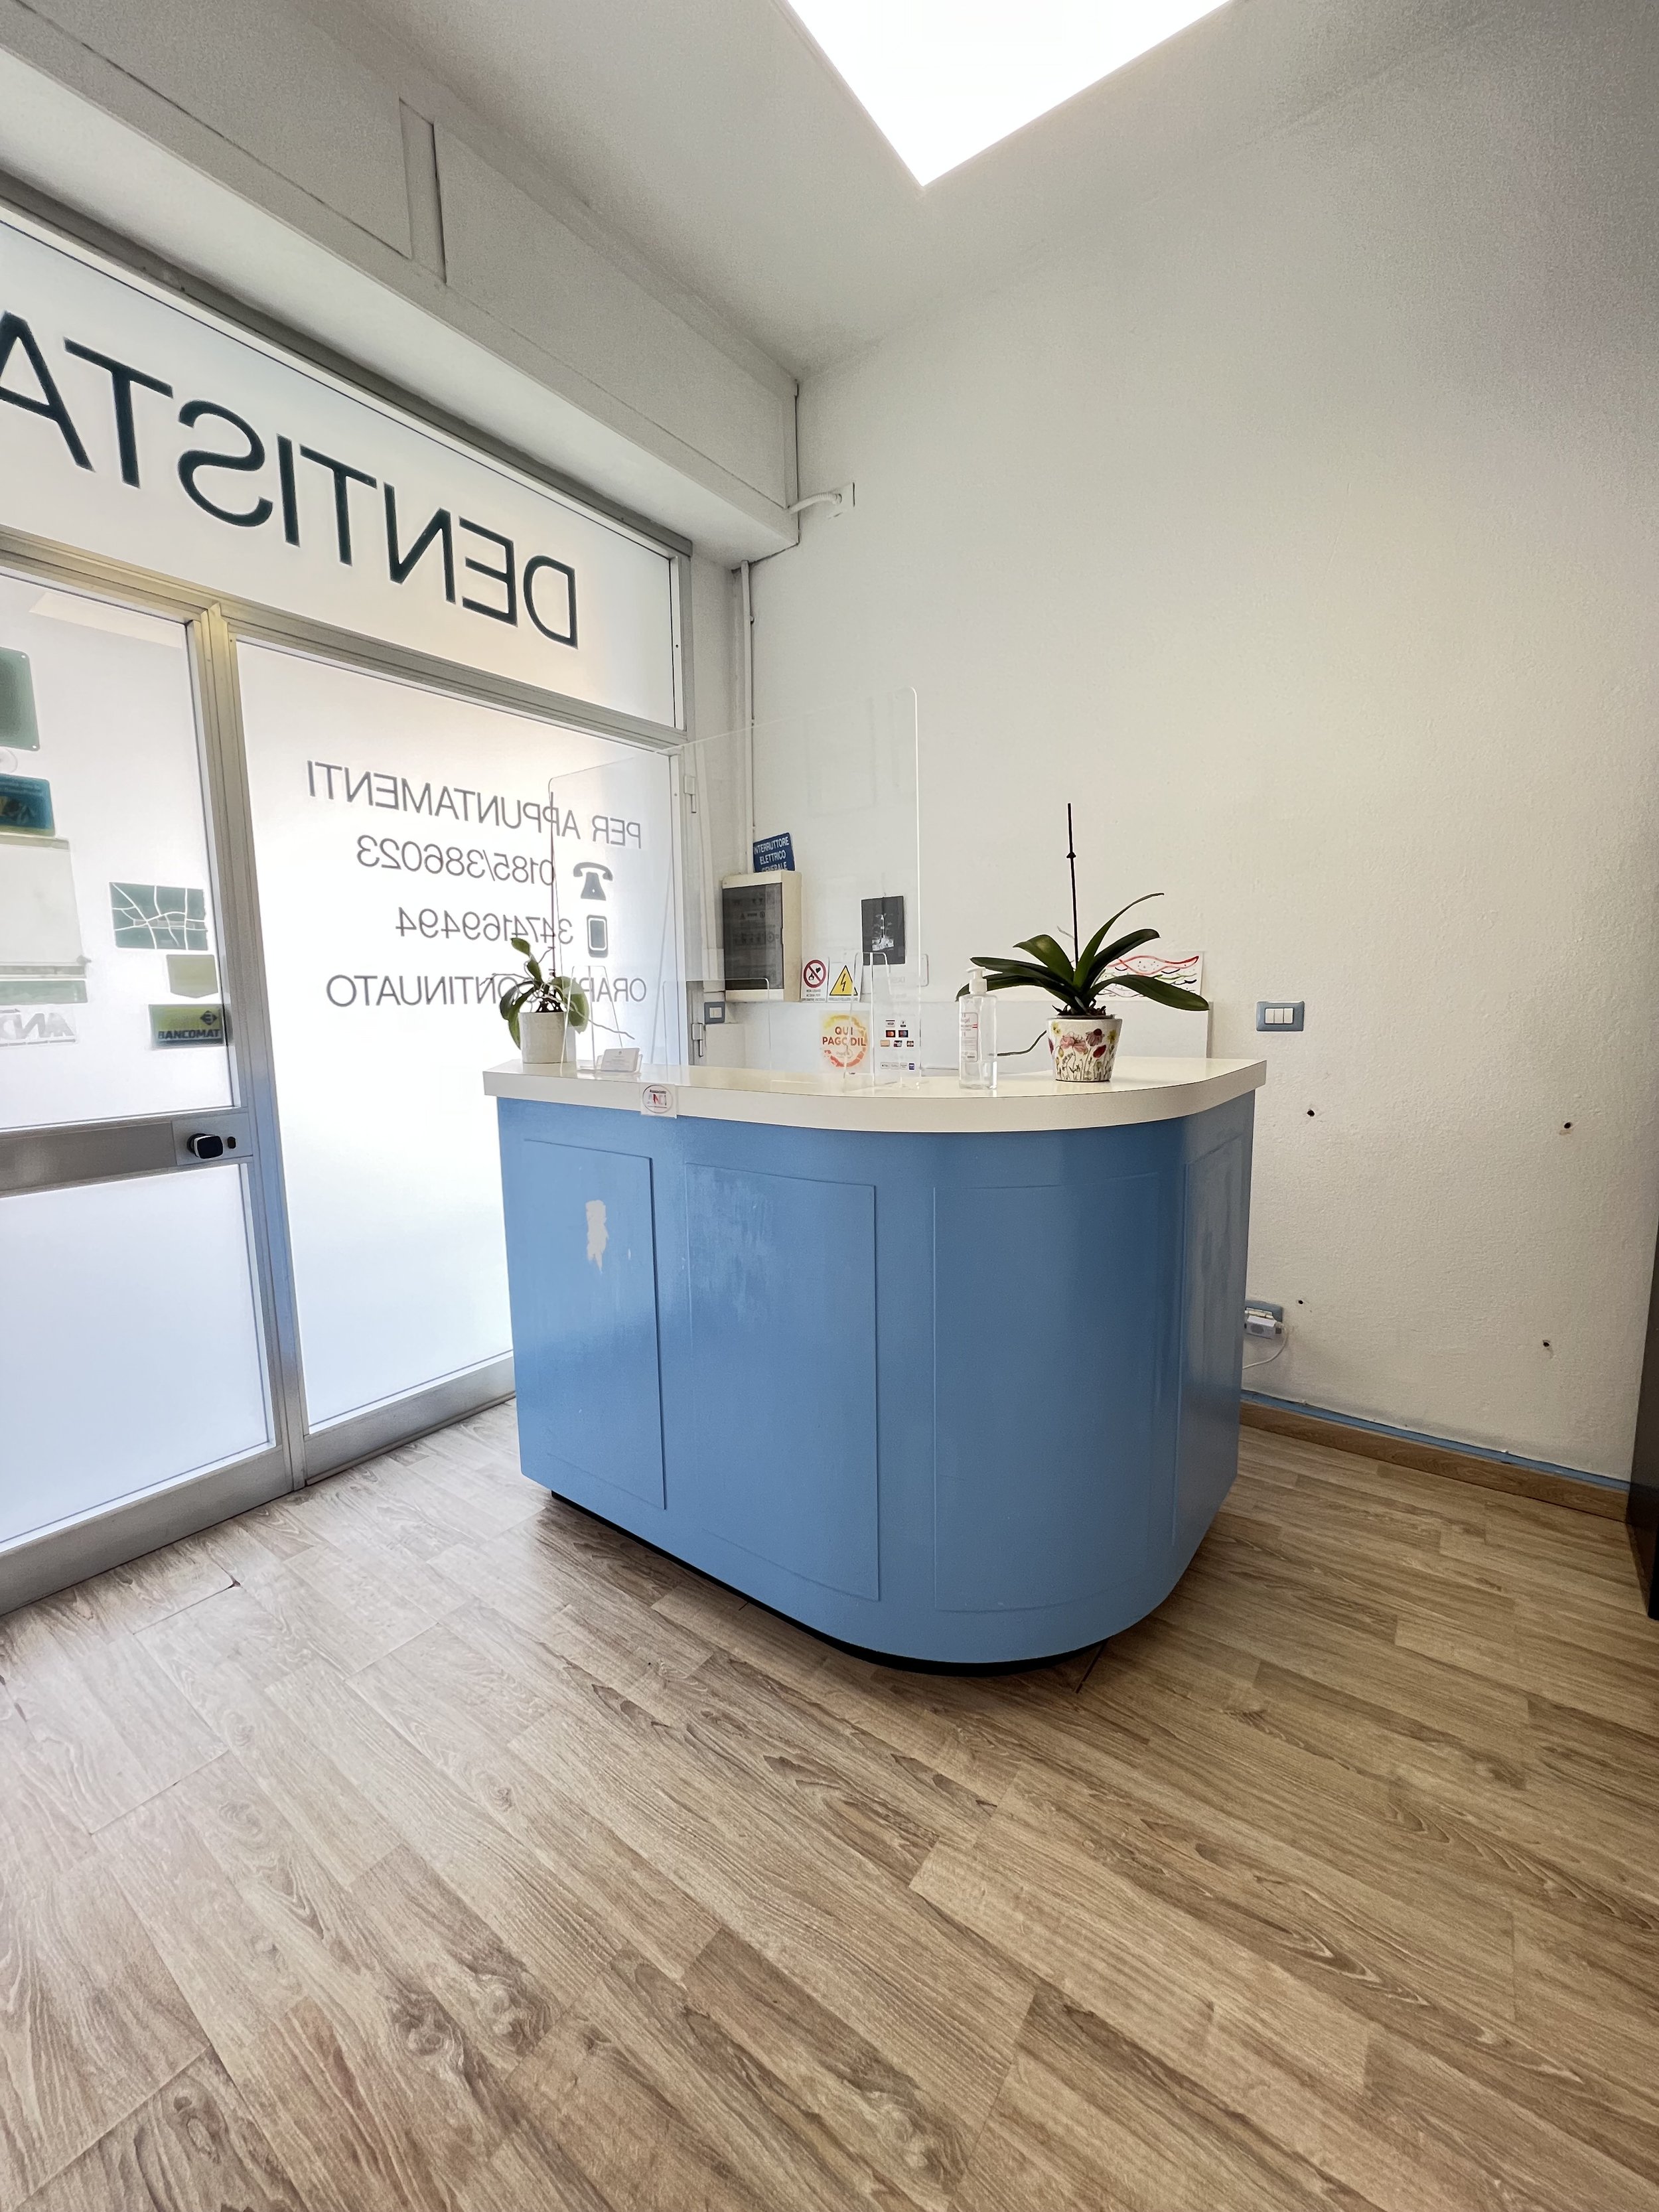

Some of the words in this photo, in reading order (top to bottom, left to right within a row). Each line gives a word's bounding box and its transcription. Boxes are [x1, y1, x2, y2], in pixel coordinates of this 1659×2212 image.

[760, 849, 786, 865] ELETTRICO
[158, 1029, 220, 1039] BANCOMAT
[835, 1027, 853, 1035] QUI
